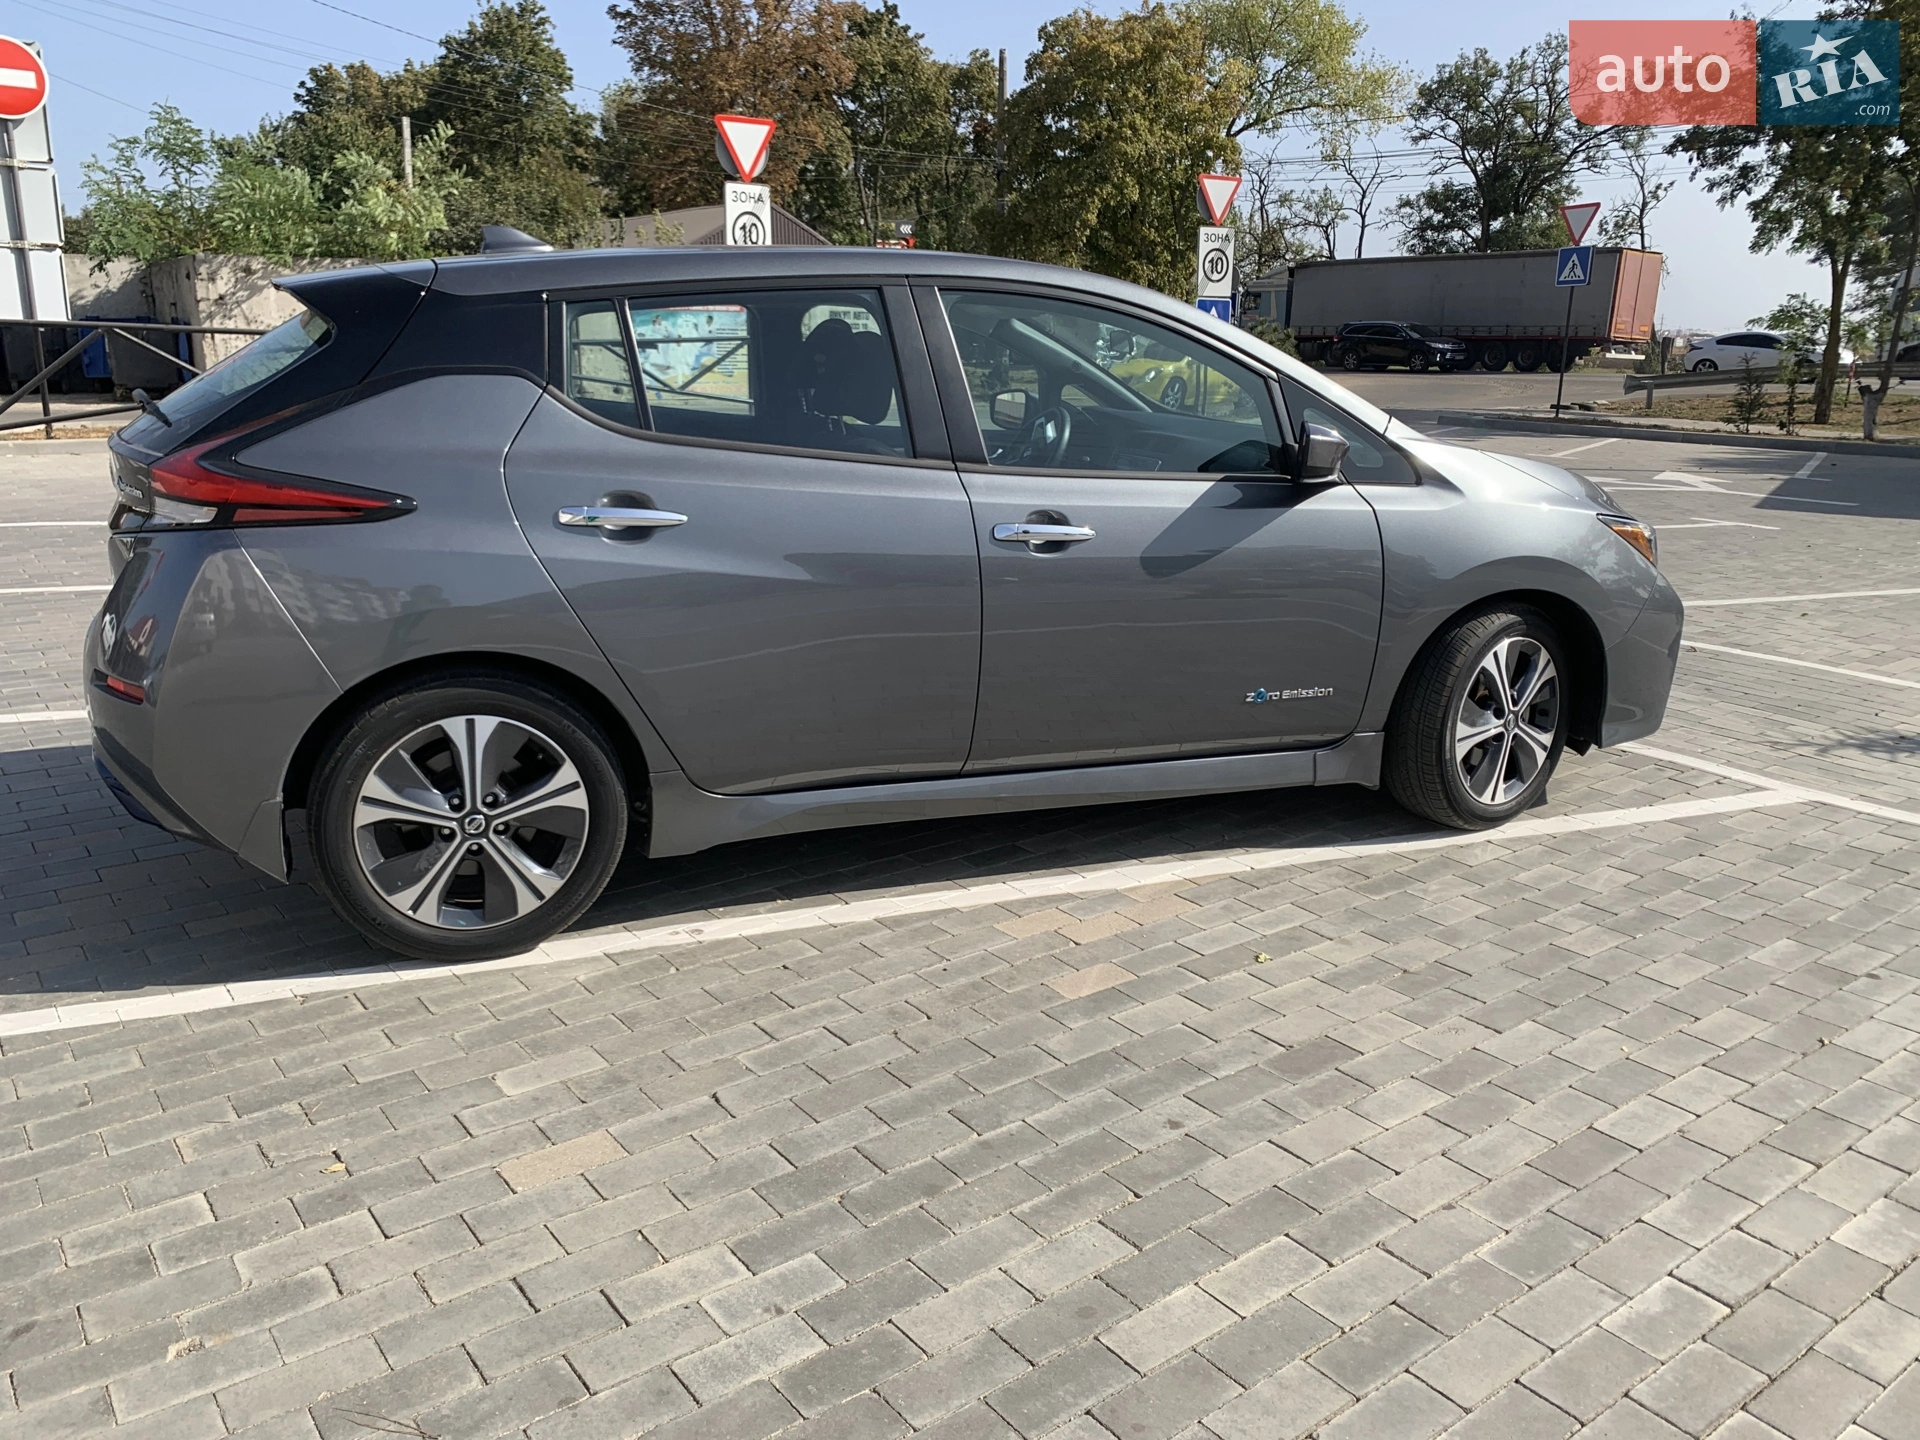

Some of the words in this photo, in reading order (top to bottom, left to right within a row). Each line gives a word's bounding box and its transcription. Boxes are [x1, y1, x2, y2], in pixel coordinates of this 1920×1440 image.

[731, 190, 765, 205] ЗОНА
[739, 222, 759, 245] 10
[1203, 232, 1231, 243] ЗОНА
[1208, 256, 1224, 275] 10
